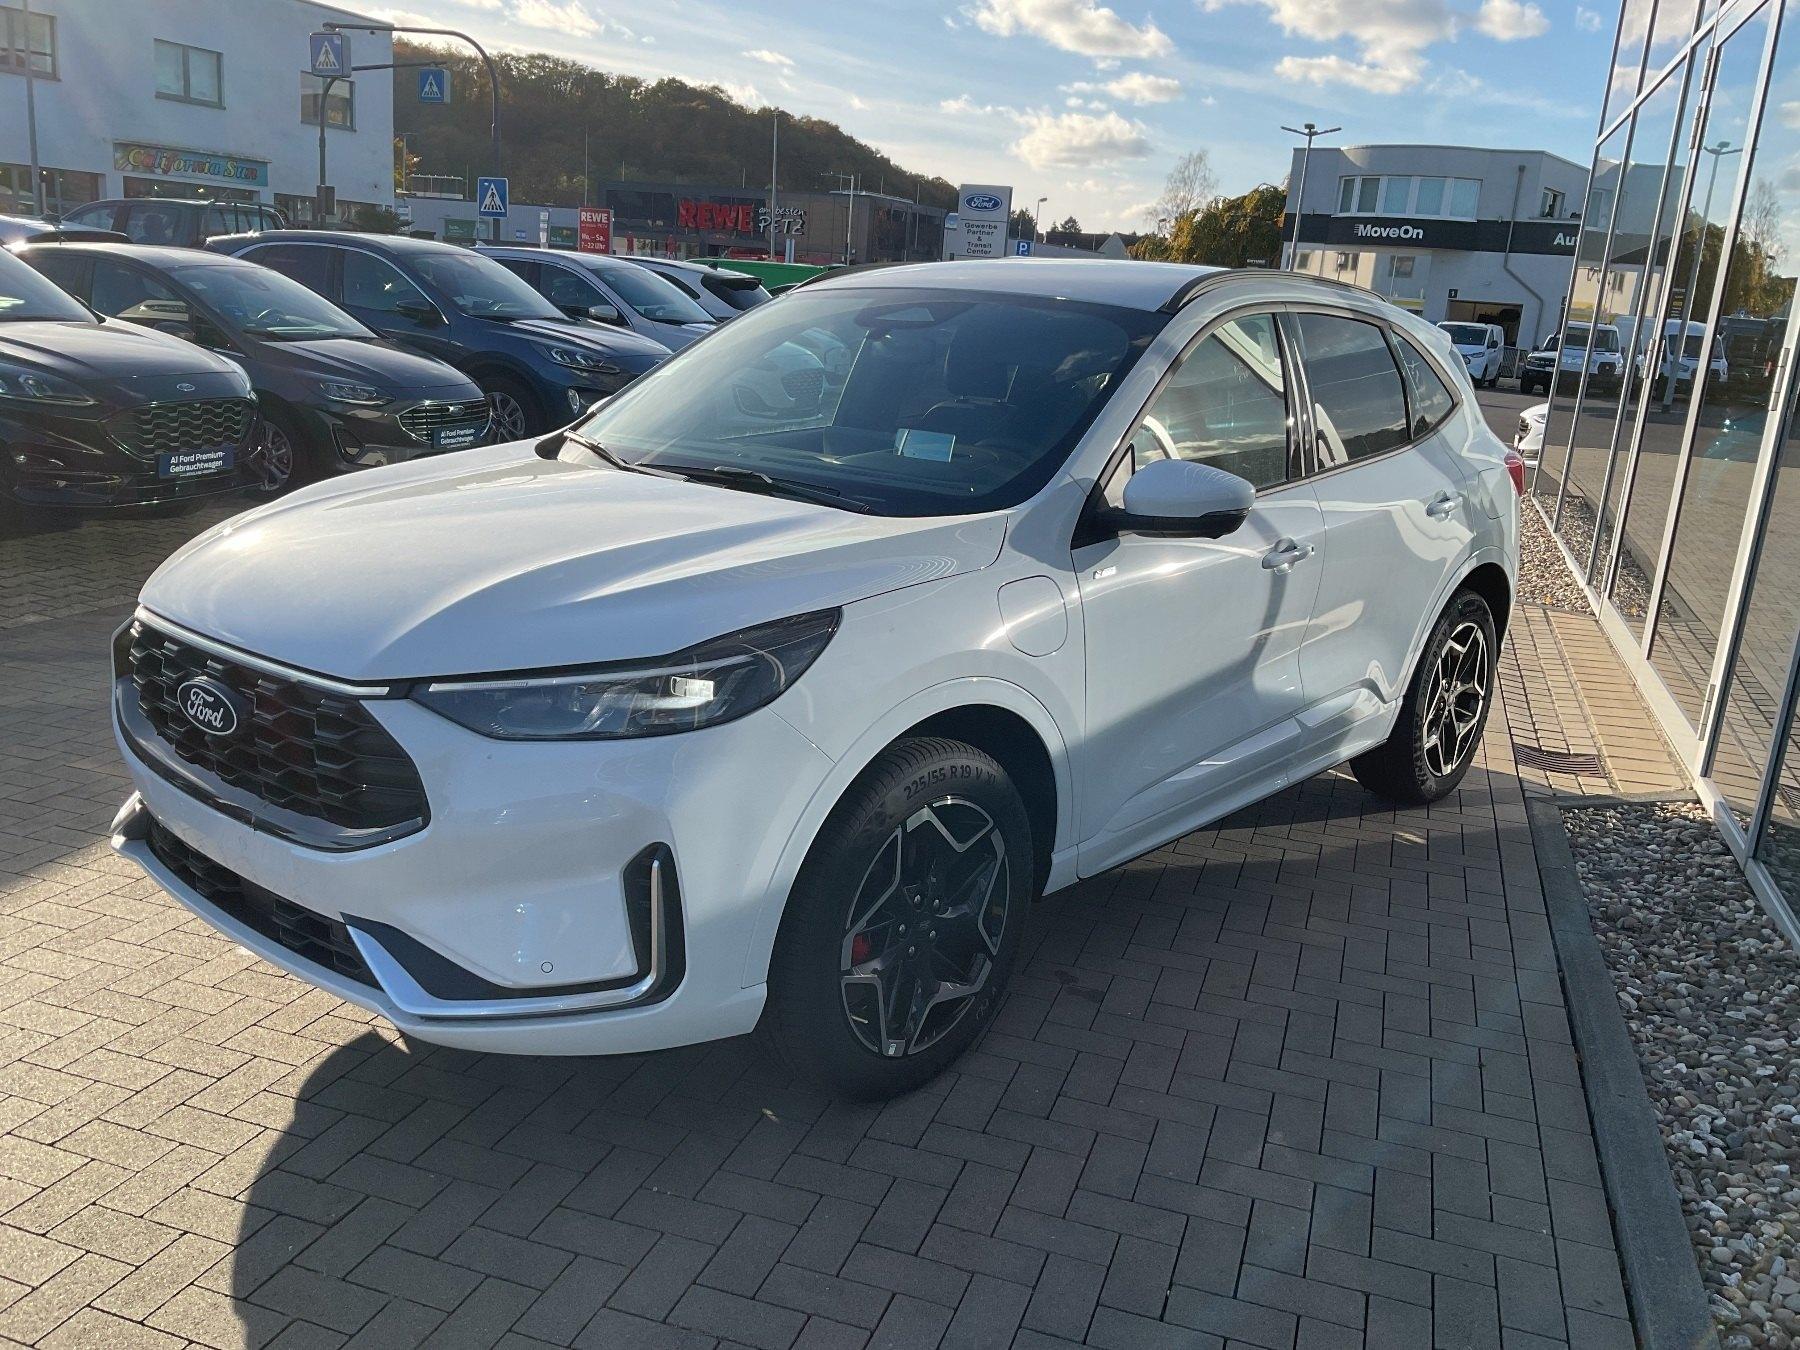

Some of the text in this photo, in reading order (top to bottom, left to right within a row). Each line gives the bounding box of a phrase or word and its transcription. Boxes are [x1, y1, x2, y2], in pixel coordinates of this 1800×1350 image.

[128, 149, 258, 180] California Sun
[580, 211, 609, 223] REWE
[678, 197, 754, 232] REWE
[775, 205, 804, 216] besten
[758, 216, 804, 235] PETZ
[964, 222, 998, 230] Gewerbe
[1355, 223, 1424, 240] MoveOn
[967, 241, 992, 249] Transit
[1553, 232, 1580, 246] Au
[1019, 242, 1028, 255] P
[179, 453, 195, 463] Ford
[195, 451, 226, 461] Premium-
[169, 460, 223, 473] Gebrauchtwagen
[187, 687, 224, 728] Ford
[903, 766, 946, 801] 225/55
